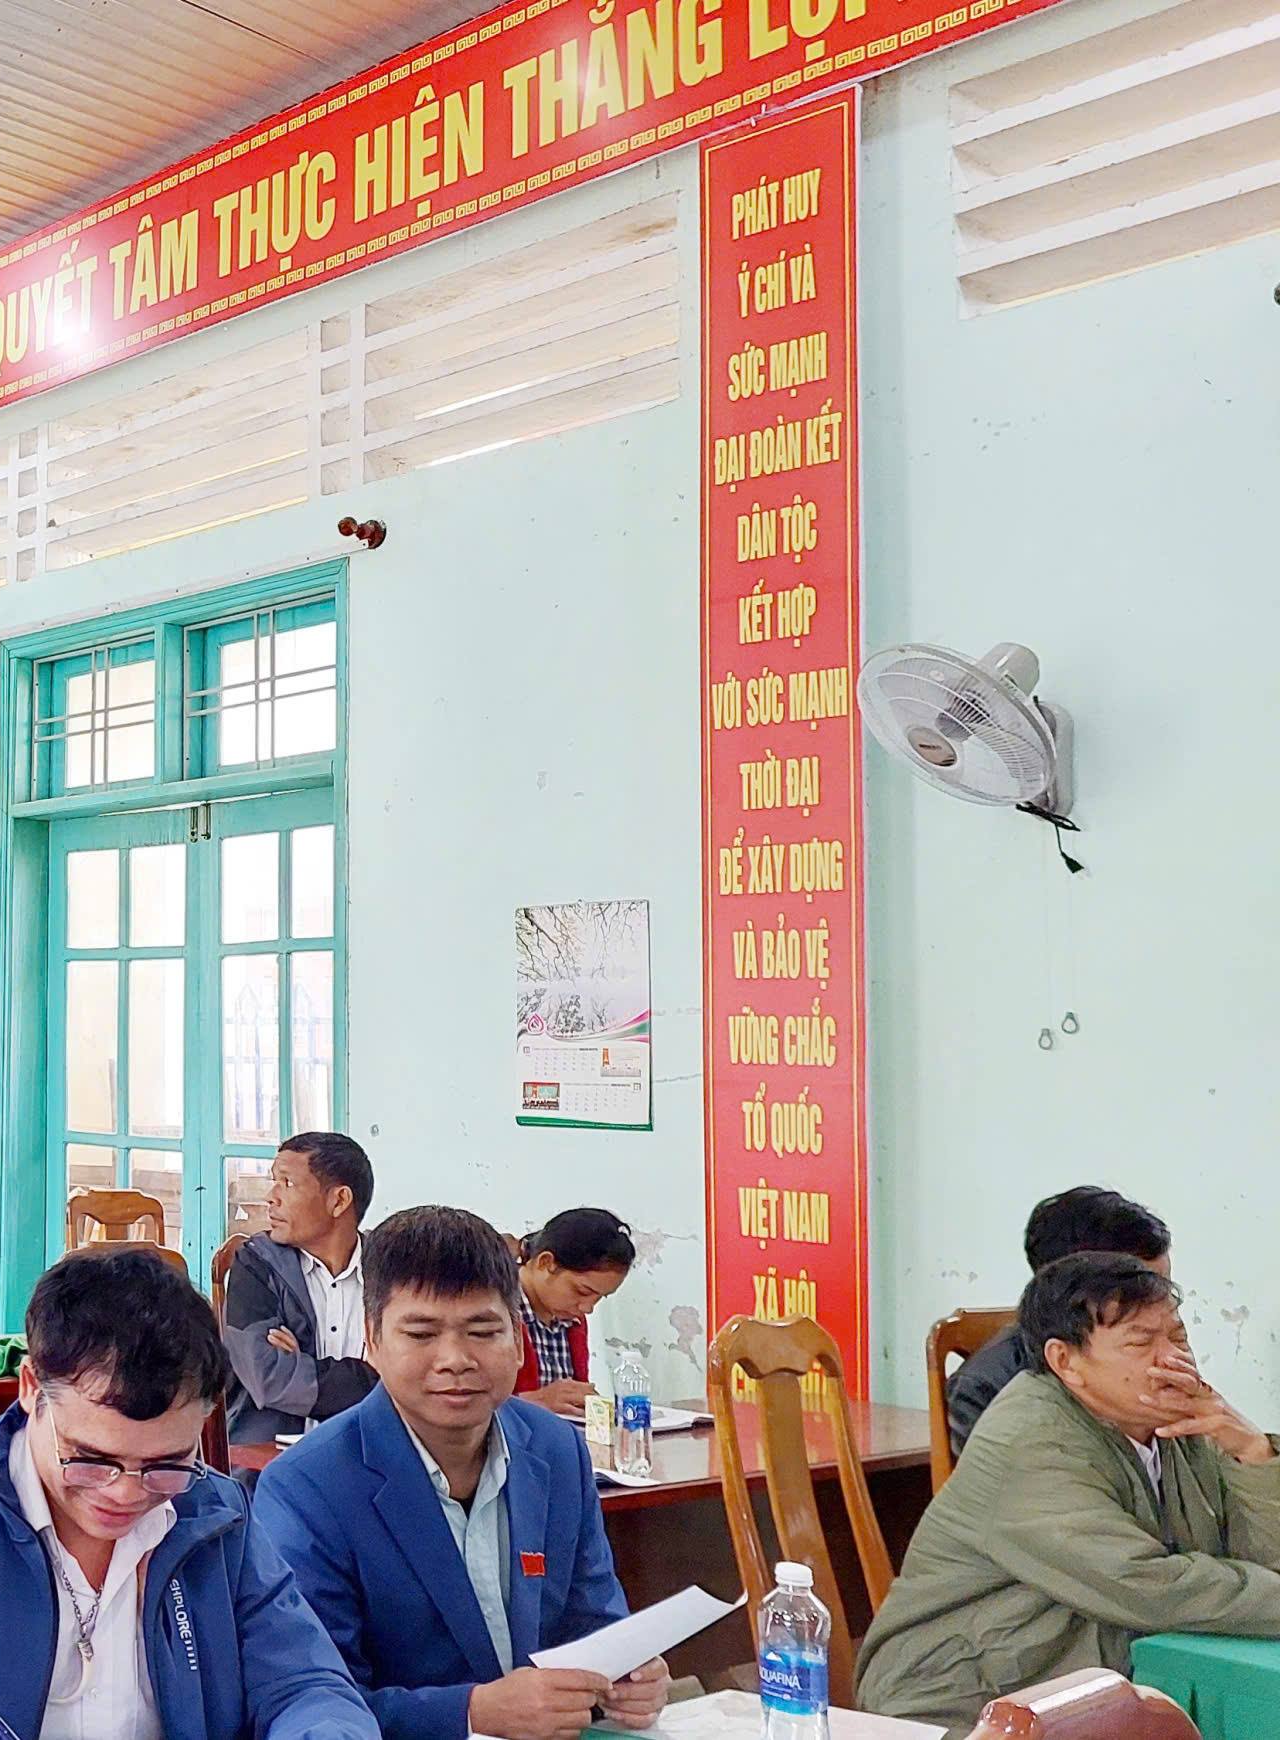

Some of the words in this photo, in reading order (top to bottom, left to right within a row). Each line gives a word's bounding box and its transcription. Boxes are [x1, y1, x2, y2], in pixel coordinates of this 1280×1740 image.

[109, 209, 201, 321] TÂM
[214, 151, 337, 279] THỰC
[354, 80, 485, 223] HIỆN
[503, 0, 723, 159] THẮNG
[733, 176, 779, 239] PHÁT
[784, 169, 820, 223] HUY
[739, 262, 750, 317] Ý
[755, 251, 785, 312] CHÍ
[791, 244, 815, 302] VÀ
[729, 342, 765, 400] SỨC
[770, 332, 826, 396] MẠNH
[715, 435, 745, 492] ĐẠI
[750, 416, 801, 477] ĐOÀN
[806, 399, 842, 465] KẾT
[738, 503, 776, 561] DÂN
[781, 495, 816, 562] TỘC
[740, 580, 773, 643] KẾT
[778, 584, 816, 646] HỢP
[712, 672, 741, 729] VỚI
[747, 668, 783, 726] SỨC
[789, 668, 847, 730] MẠNH
[740, 750, 781, 809] THỜI
[786, 757, 819, 816] ĐẠI
[719, 828, 744, 894] ĐỂ
[748, 836, 784, 893] XÂY
[790, 838, 843, 902] DỰNG
[733, 921, 757, 978] VÀ
[762, 914, 800, 978] BẢO
[805, 919, 829, 989] VỆ
[728, 1007, 779, 1064] VỮNG
[784, 997, 836, 1066] CHẮC
[742, 1082, 766, 1151] TỔ
[771, 1087, 822, 1157] QUỐC
[739, 1178, 778, 1248] VIỆT
[784, 1191, 828, 1243] NAM
[753, 1266, 779, 1321] XÃ
